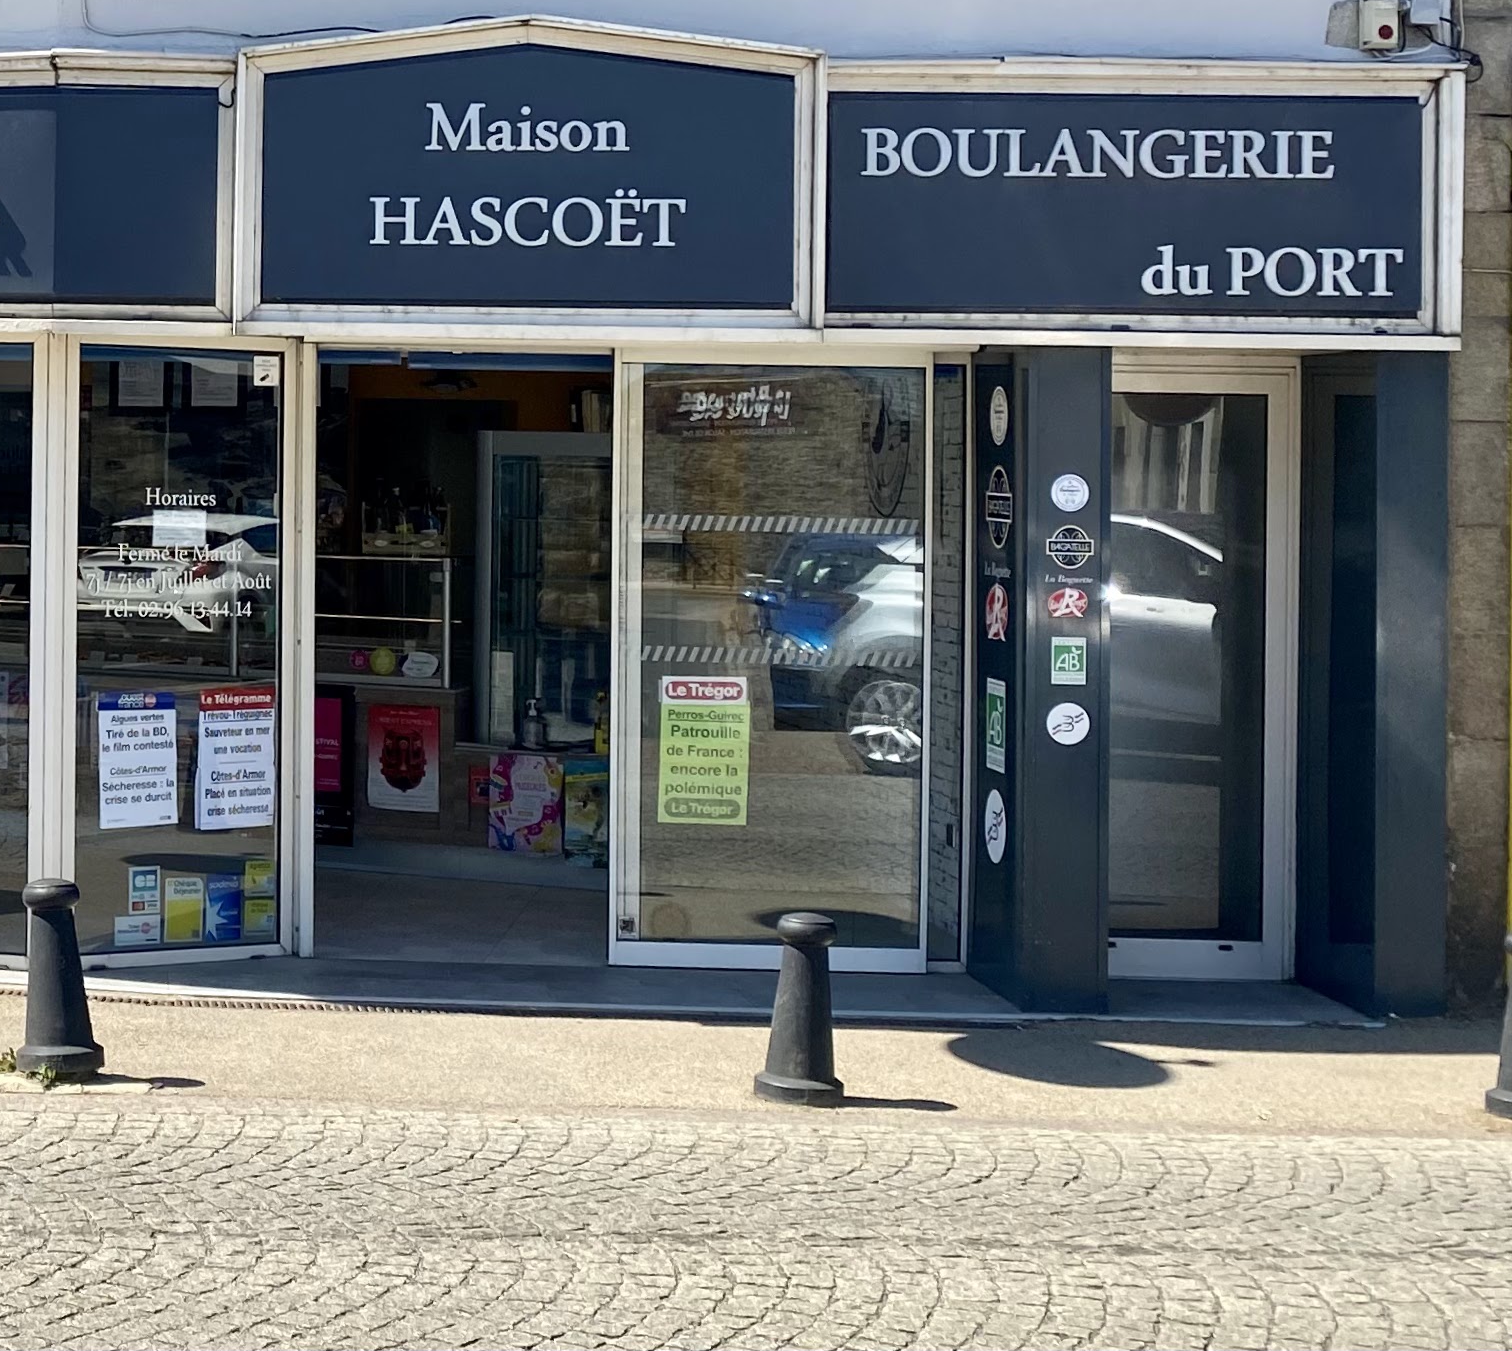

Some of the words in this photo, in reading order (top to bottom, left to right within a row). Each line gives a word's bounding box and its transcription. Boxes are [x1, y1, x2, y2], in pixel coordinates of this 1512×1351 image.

[425, 102, 630, 152] Maison
[860, 127, 1335, 179] BOULANGERIE
[369, 188, 686, 248] HASCOËT
[1140, 244, 1213, 298] du
[1226, 247, 1403, 298] PORT
[145, 487, 217, 507] Horaires
[117, 542, 170, 562] Fermé
[174, 542, 188, 561] le
[192, 540, 243, 562] Mardi
[1050, 541, 1091, 552] BAGATELLE
[86, 573, 100, 597] 7j
[118, 572, 133, 595] 7j
[136, 577, 156, 589] en
[158, 569, 209, 594] Juillet
[212, 573, 228, 590] et
[231, 571, 272, 590] Août
[101, 598, 133, 618] Tél.
[138, 599, 252, 619] 02.96.13.44.14
[1055, 652, 1081, 671] AB
[668, 684, 687, 697] Le
[688, 682, 741, 699] Trégor
[201, 694, 212, 704] Le
[214, 693, 272, 706] Télégramme
[111, 714, 138, 725] Algues
[140, 713, 165, 722] vertes
[667, 709, 745, 721] Perros-Guirec
[106, 729, 125, 739] Tiré
[127, 728, 139, 738] de
[142, 727, 150, 737] la
[152, 726, 170, 738] BD,
[204, 727, 243, 738] Sauveteur
[244, 727, 254, 736] en
[255, 726, 270, 735] mer
[670, 724, 741, 739] Patrouille
[102, 743, 111, 753] le
[113, 742, 131, 752] film
[133, 738, 174, 751] contesté
[213, 746, 228, 755] une
[230, 744, 262, 754] vocation
[666, 745, 684, 757] de
[687, 745, 735, 758] France
[109, 765, 167, 776] Côtes-d'Armor
[210, 769, 266, 782] Côtes-d'Armor
[670, 764, 722, 777] encore
[726, 764, 738, 777] la
[102, 780, 157, 792] Sécheresse
[165, 778, 175, 788] la
[664, 781, 742, 798] polémique
[105, 796, 128, 805] crise
[130, 795, 142, 803] se
[144, 791, 172, 802] durcit
[204, 788, 225, 799] Placé
[227, 789, 238, 798] en
[239, 786, 272, 797] situation
[207, 806, 226, 817] crise
[227, 804, 269, 815] sécheresse
[671, 802, 688, 813] Le
[688, 802, 734, 817] Trégor
